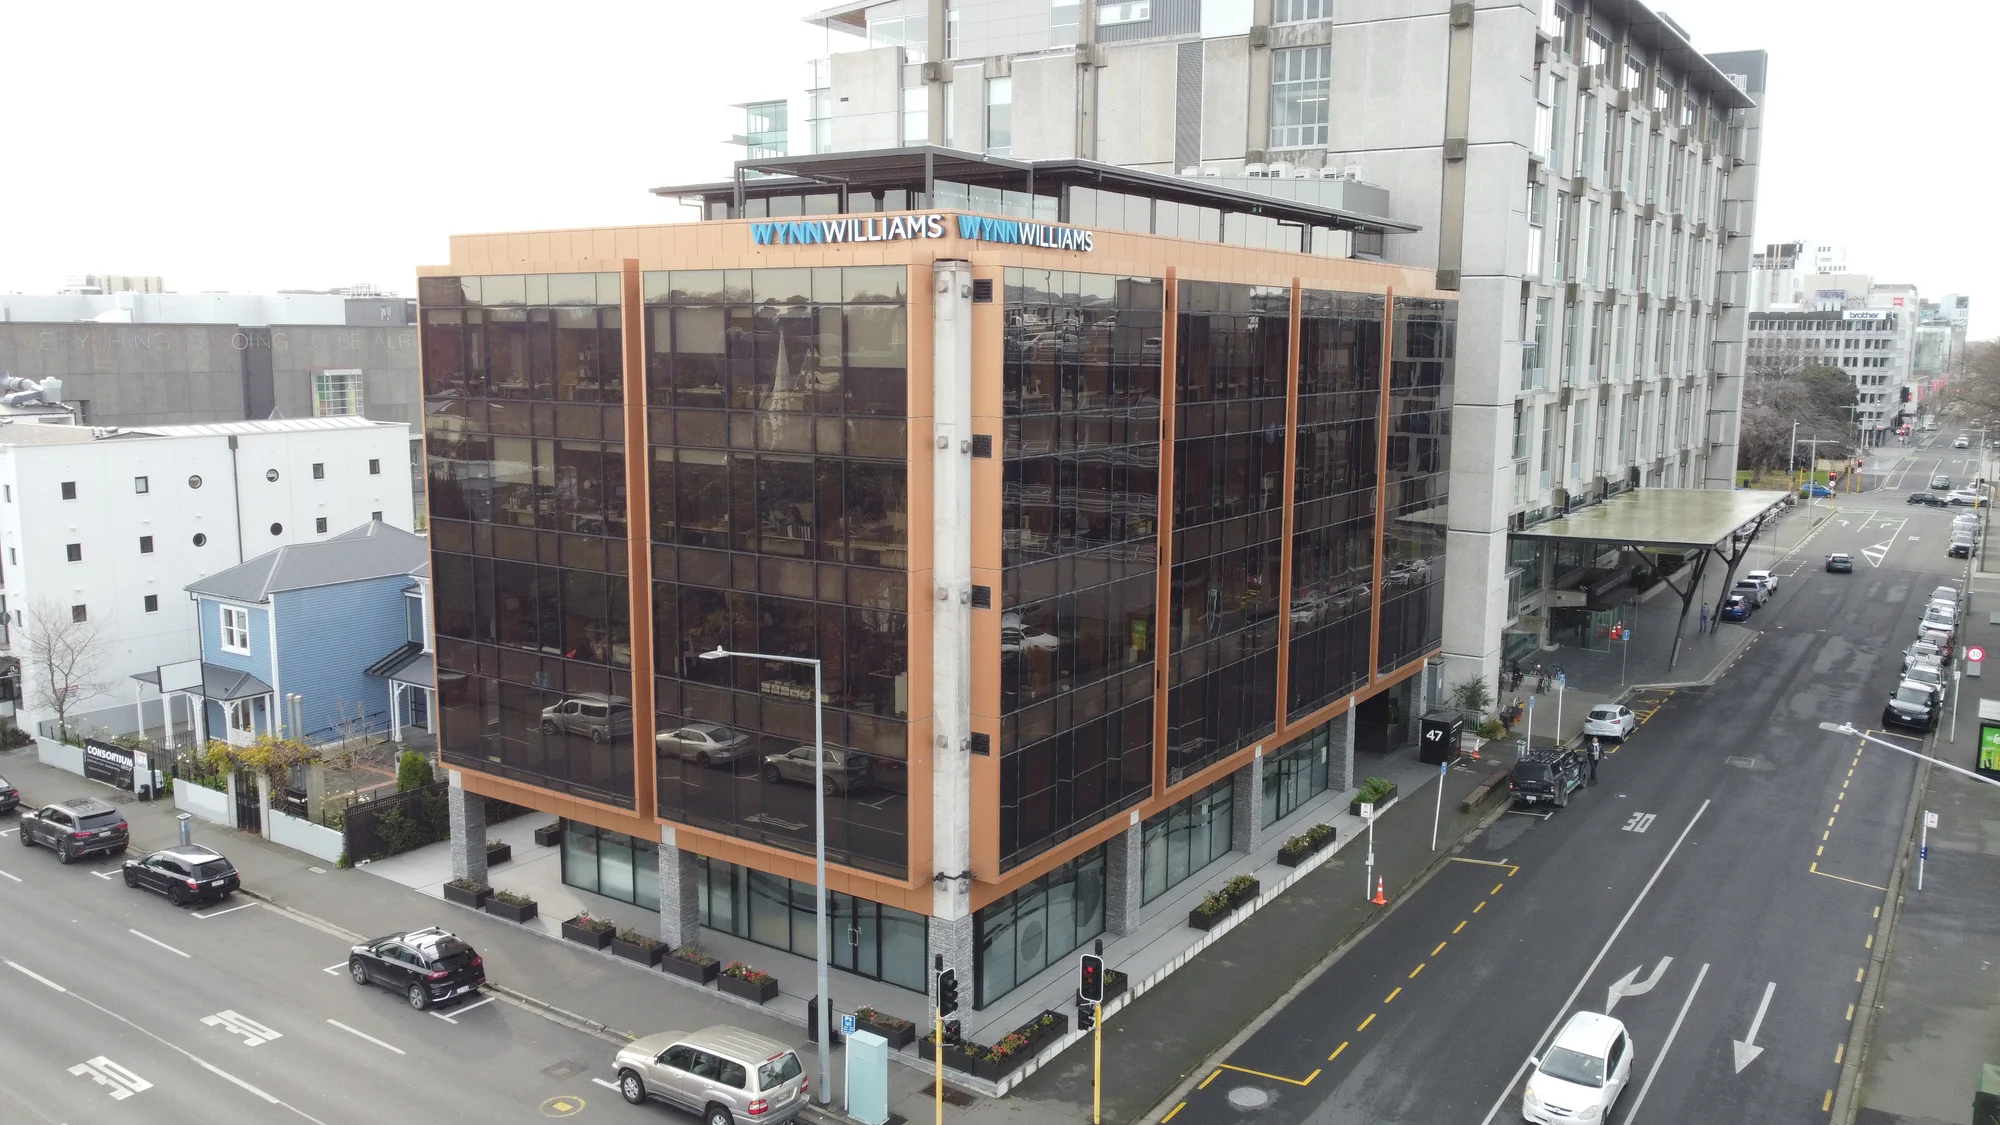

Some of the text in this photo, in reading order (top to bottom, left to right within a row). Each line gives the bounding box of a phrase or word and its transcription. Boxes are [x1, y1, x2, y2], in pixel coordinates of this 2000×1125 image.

[1426, 730, 1443, 741] 47
[87, 745, 133, 767] CONSORTIUM
[1621, 811, 1657, 833] 30
